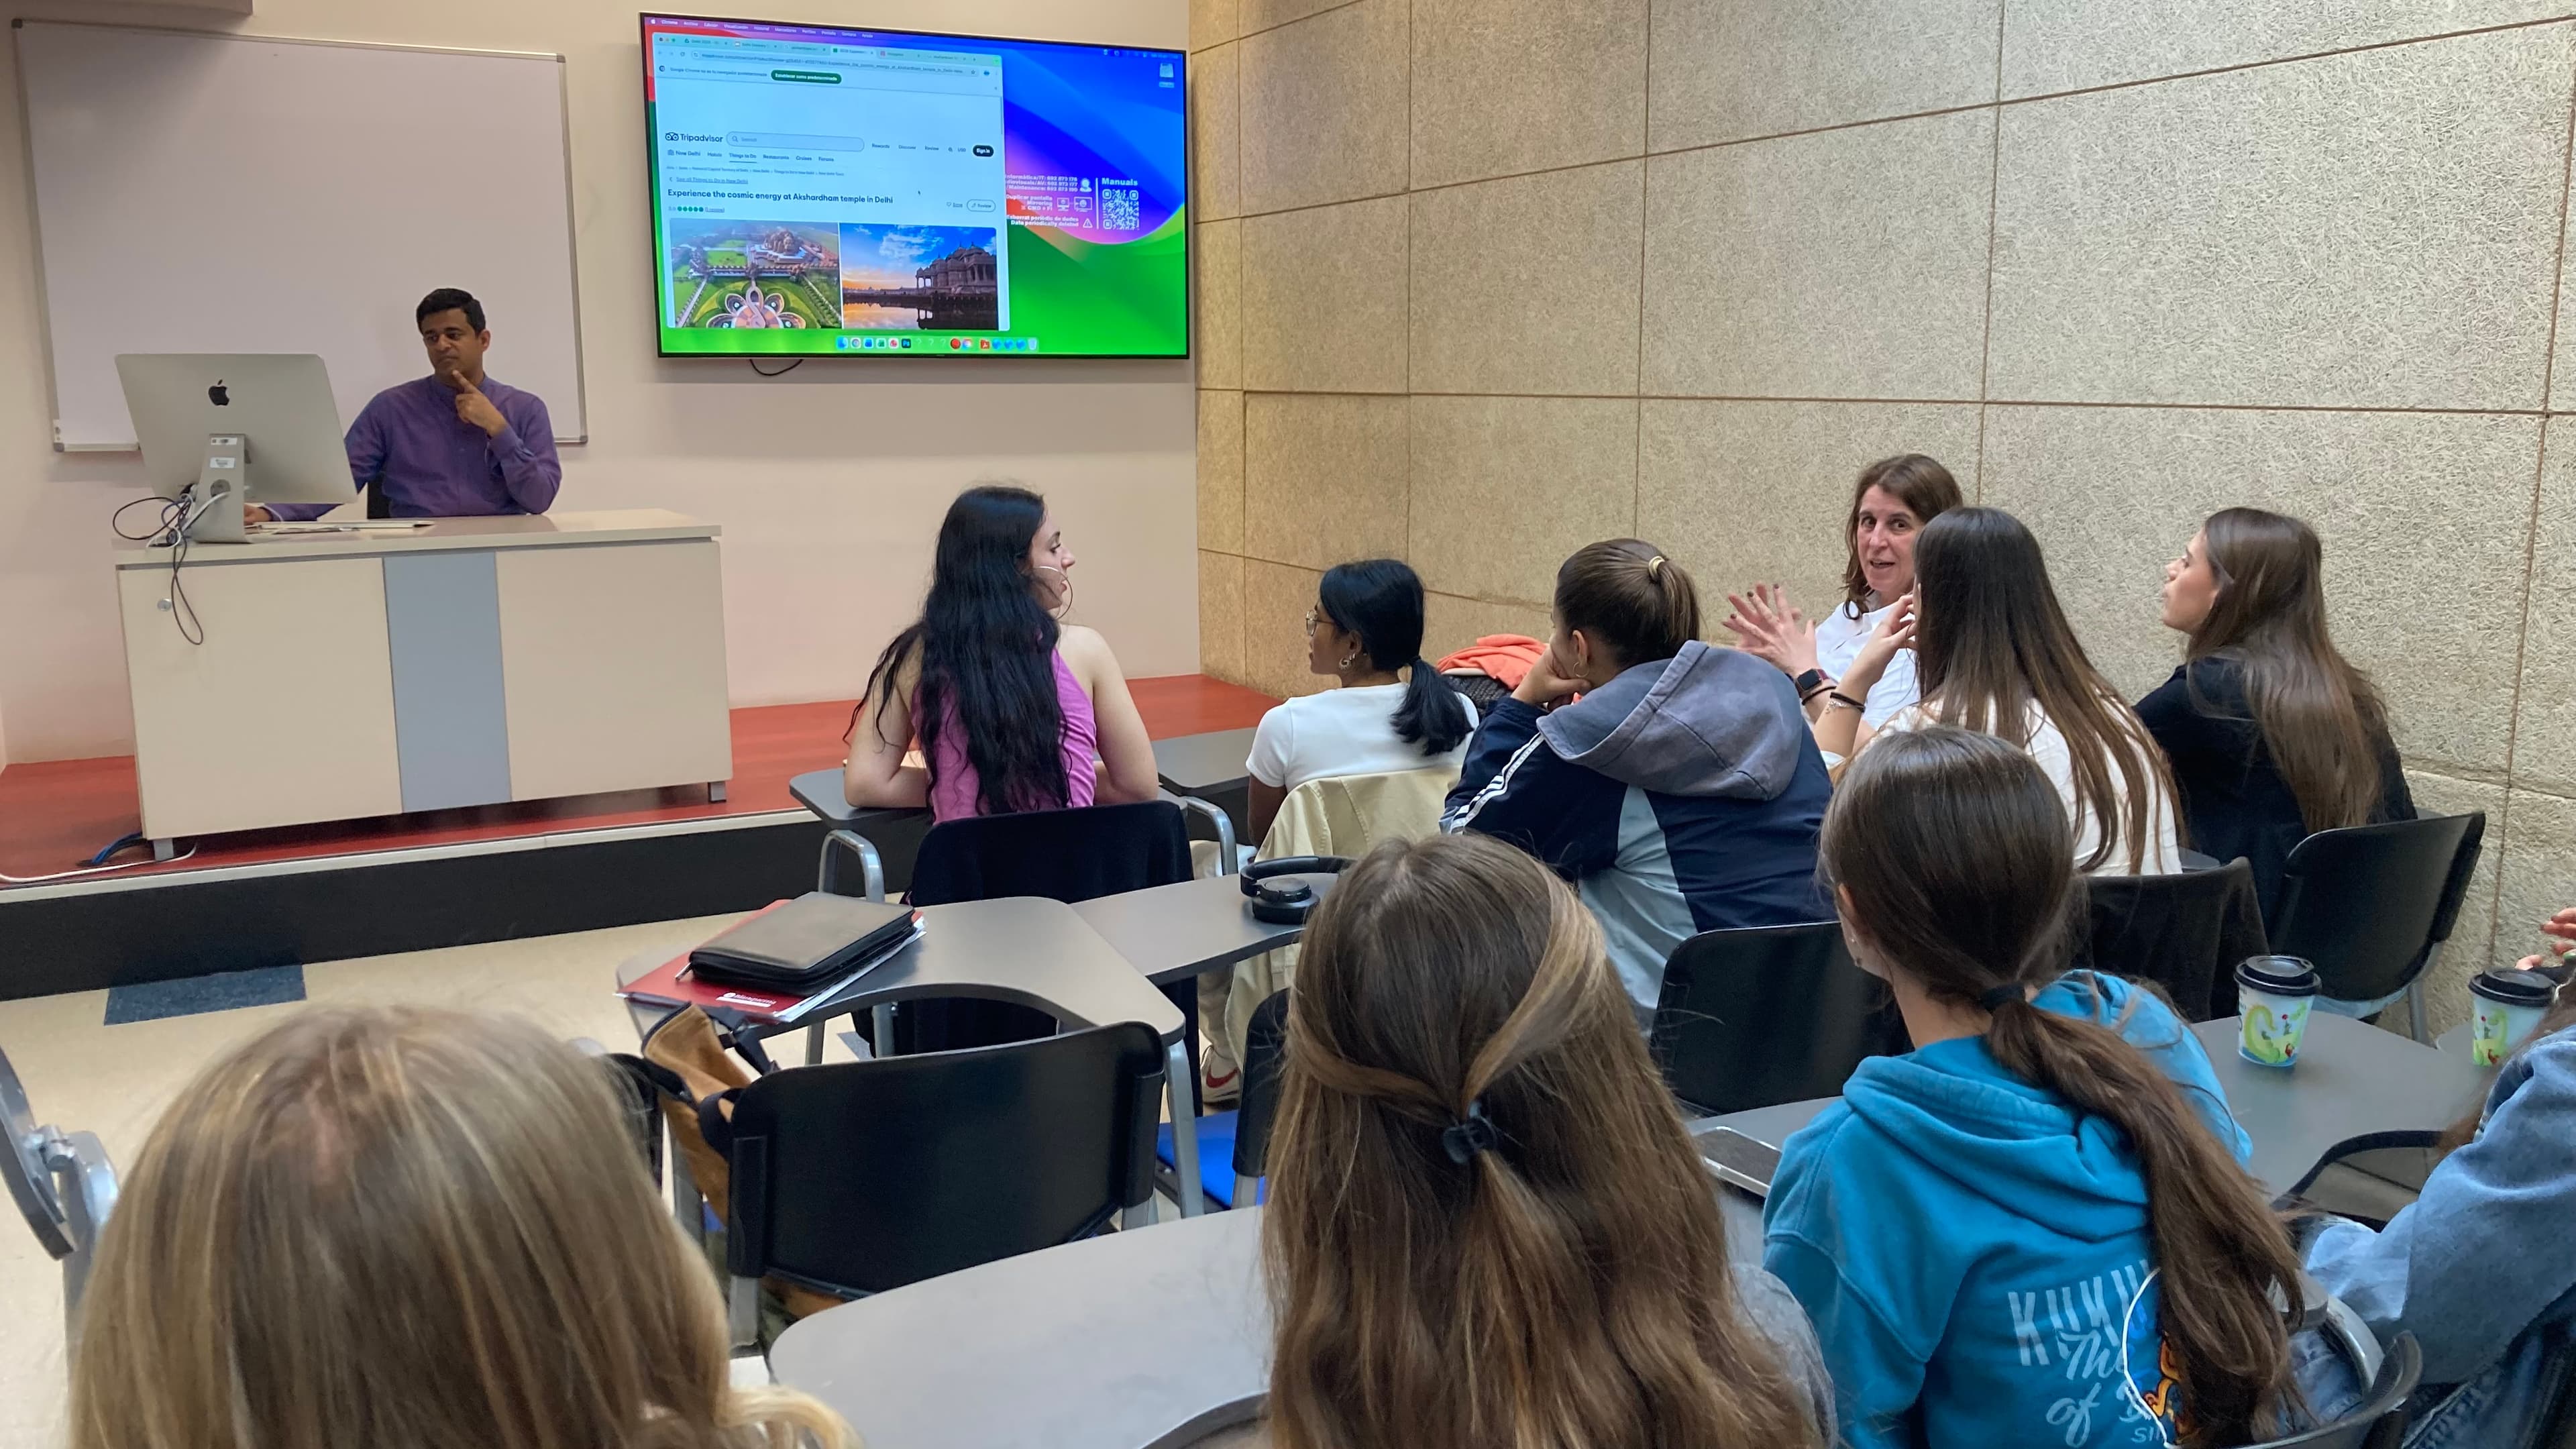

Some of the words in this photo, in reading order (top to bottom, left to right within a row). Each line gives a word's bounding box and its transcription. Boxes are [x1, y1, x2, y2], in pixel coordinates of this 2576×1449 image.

[680, 133, 723, 142] Tripadvisor
[1102, 177, 1138, 186] Manuals
[668, 189, 711, 198] Experience
[712, 190, 726, 198] the
[755, 193, 782, 201] energy
[793, 193, 839, 202] Akshardham
[841, 195, 865, 204] temple
[875, 196, 894, 204] Delhi
